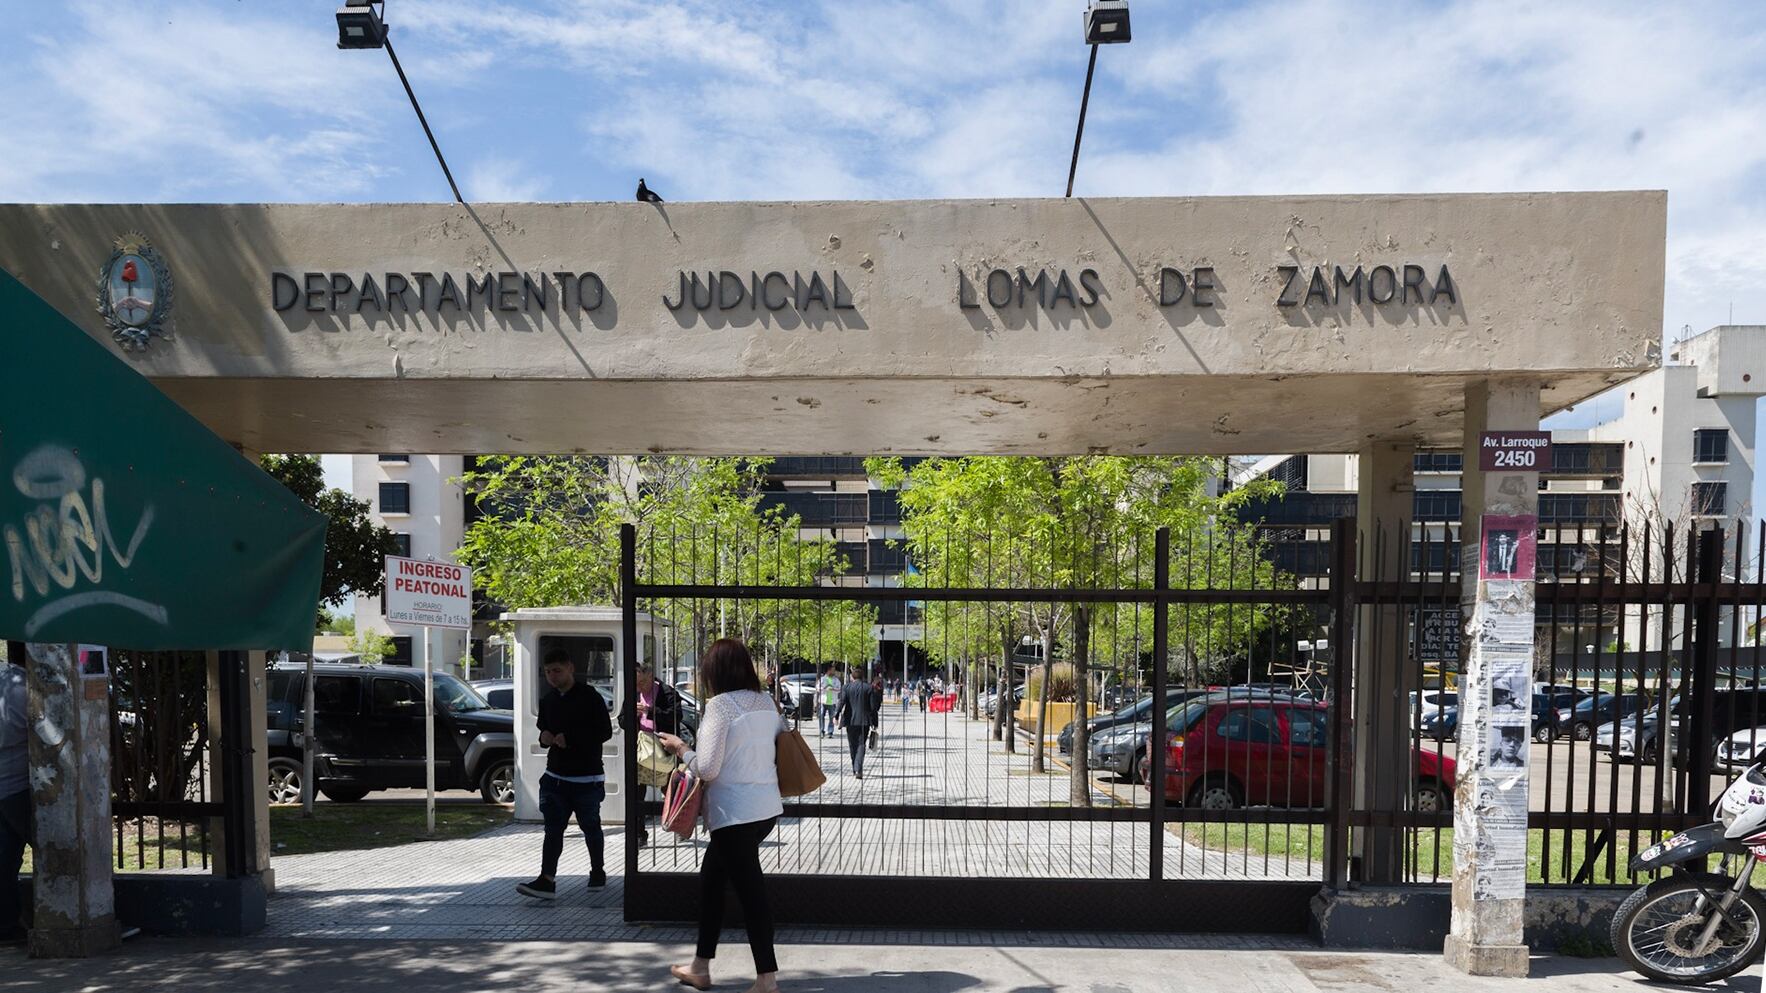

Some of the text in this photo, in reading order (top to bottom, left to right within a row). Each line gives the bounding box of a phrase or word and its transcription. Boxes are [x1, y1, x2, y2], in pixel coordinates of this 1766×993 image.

[271, 264, 1457, 312] DEPARTAMENTO JUDICIAL LOMAS DE ZAMORA
[1483, 436, 1548, 449] Av. Larroque
[1494, 450, 1536, 467] 2450
[400, 561, 461, 580] INGRESO
[395, 577, 467, 598] PEATONAL
[390, 610, 408, 620] Lunes
[413, 612, 435, 622] Viernes
[436, 614, 443, 623] de
[453, 615, 460, 624] 15
